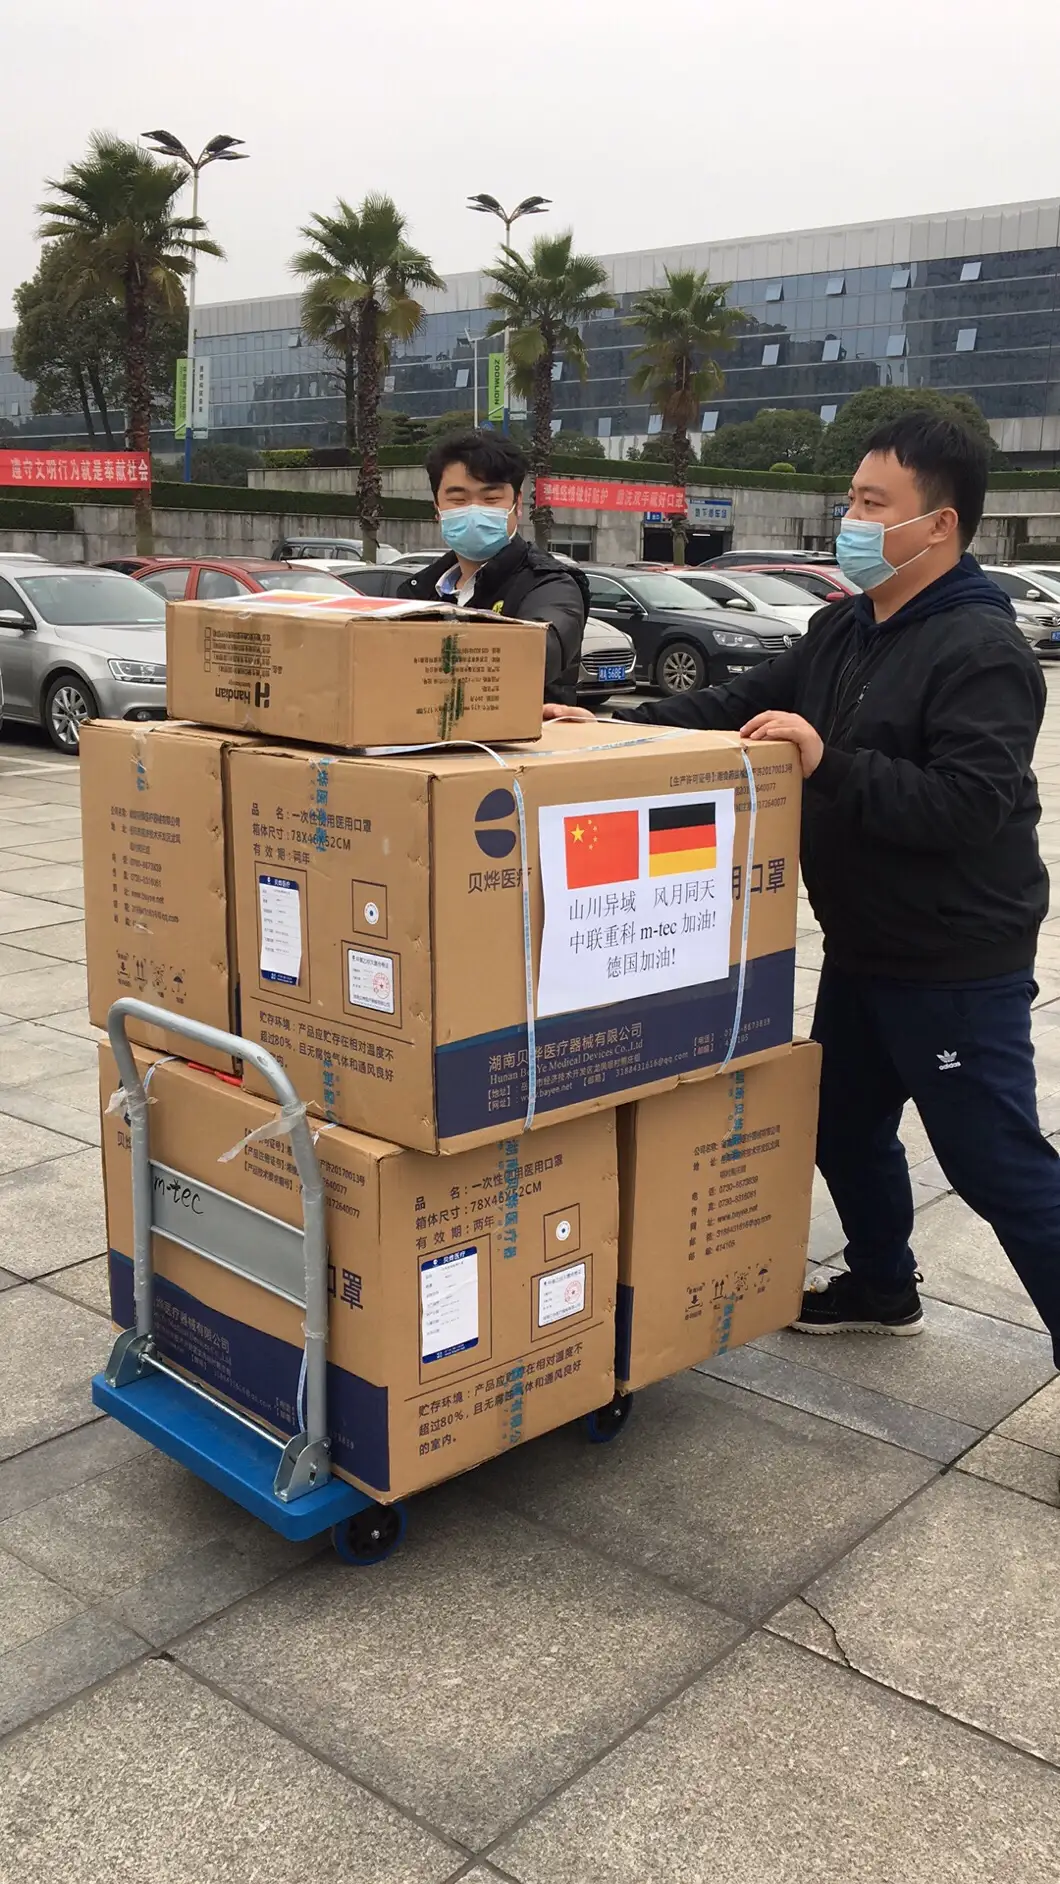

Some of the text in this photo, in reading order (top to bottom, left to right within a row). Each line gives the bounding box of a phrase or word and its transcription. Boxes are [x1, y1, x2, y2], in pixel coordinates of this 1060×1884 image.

[569, 879, 716, 921] 山川异域 风月同天
[570, 921, 636, 954] 中联重科
[640, 920, 678, 940] m-tec
[724, 1034, 748, 1046] 4105
[490, 1072, 518, 1085] Hunan
[550, 1056, 581, 1071] Medical
[583, 1049, 614, 1062] Devices
[414, 1196, 426, 1212] 品
[416, 1236, 428, 1250] 有
[434, 1232, 445, 1246] 效
